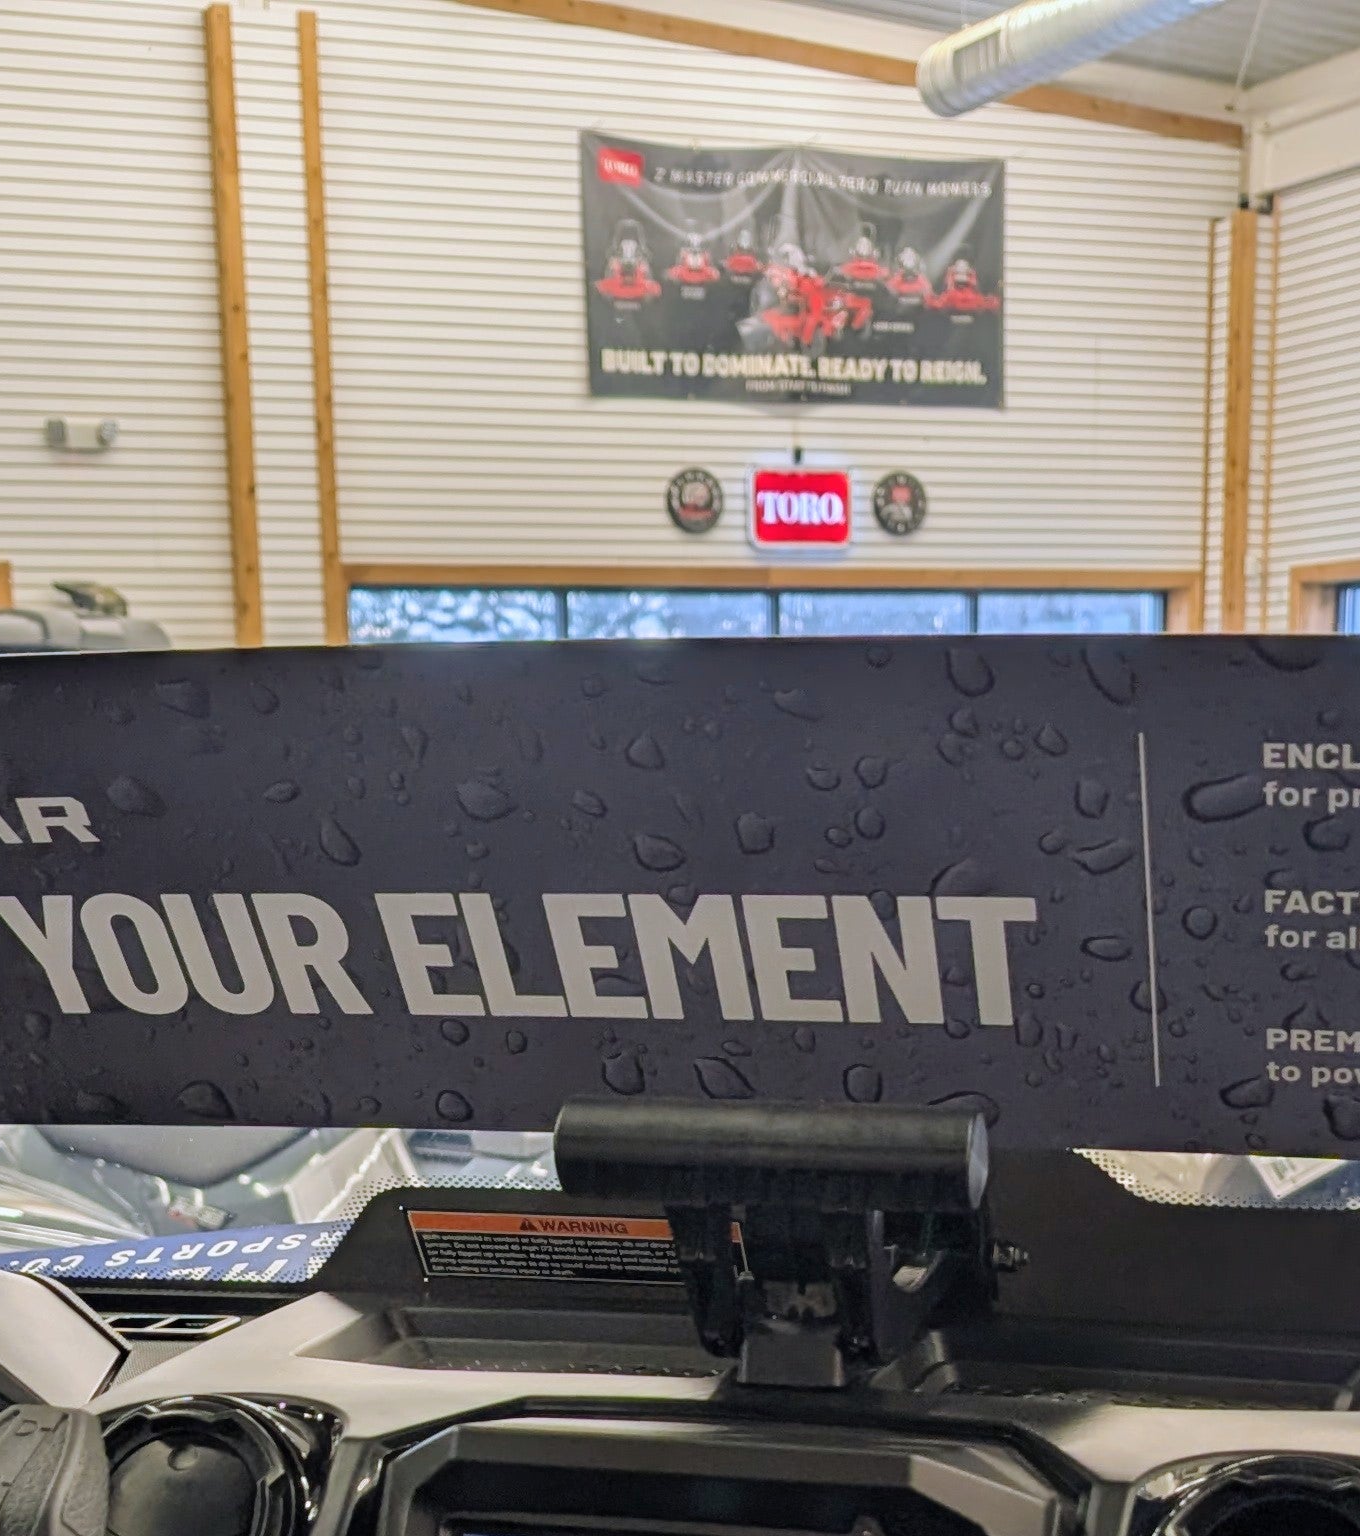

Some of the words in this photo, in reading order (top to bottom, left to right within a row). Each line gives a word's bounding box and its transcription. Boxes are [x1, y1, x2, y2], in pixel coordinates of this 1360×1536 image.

[601, 349, 667, 375] BUILT
[669, 351, 700, 376] TO
[819, 357, 886, 382] READY
[888, 359, 918, 383] TO
[1262, 780, 1318, 809] for
[1264, 924, 1318, 950] for
[375, 891, 1037, 1028] ELEMENT
[1265, 1061, 1302, 1083] to
[538, 1218, 629, 1235] WARNING
